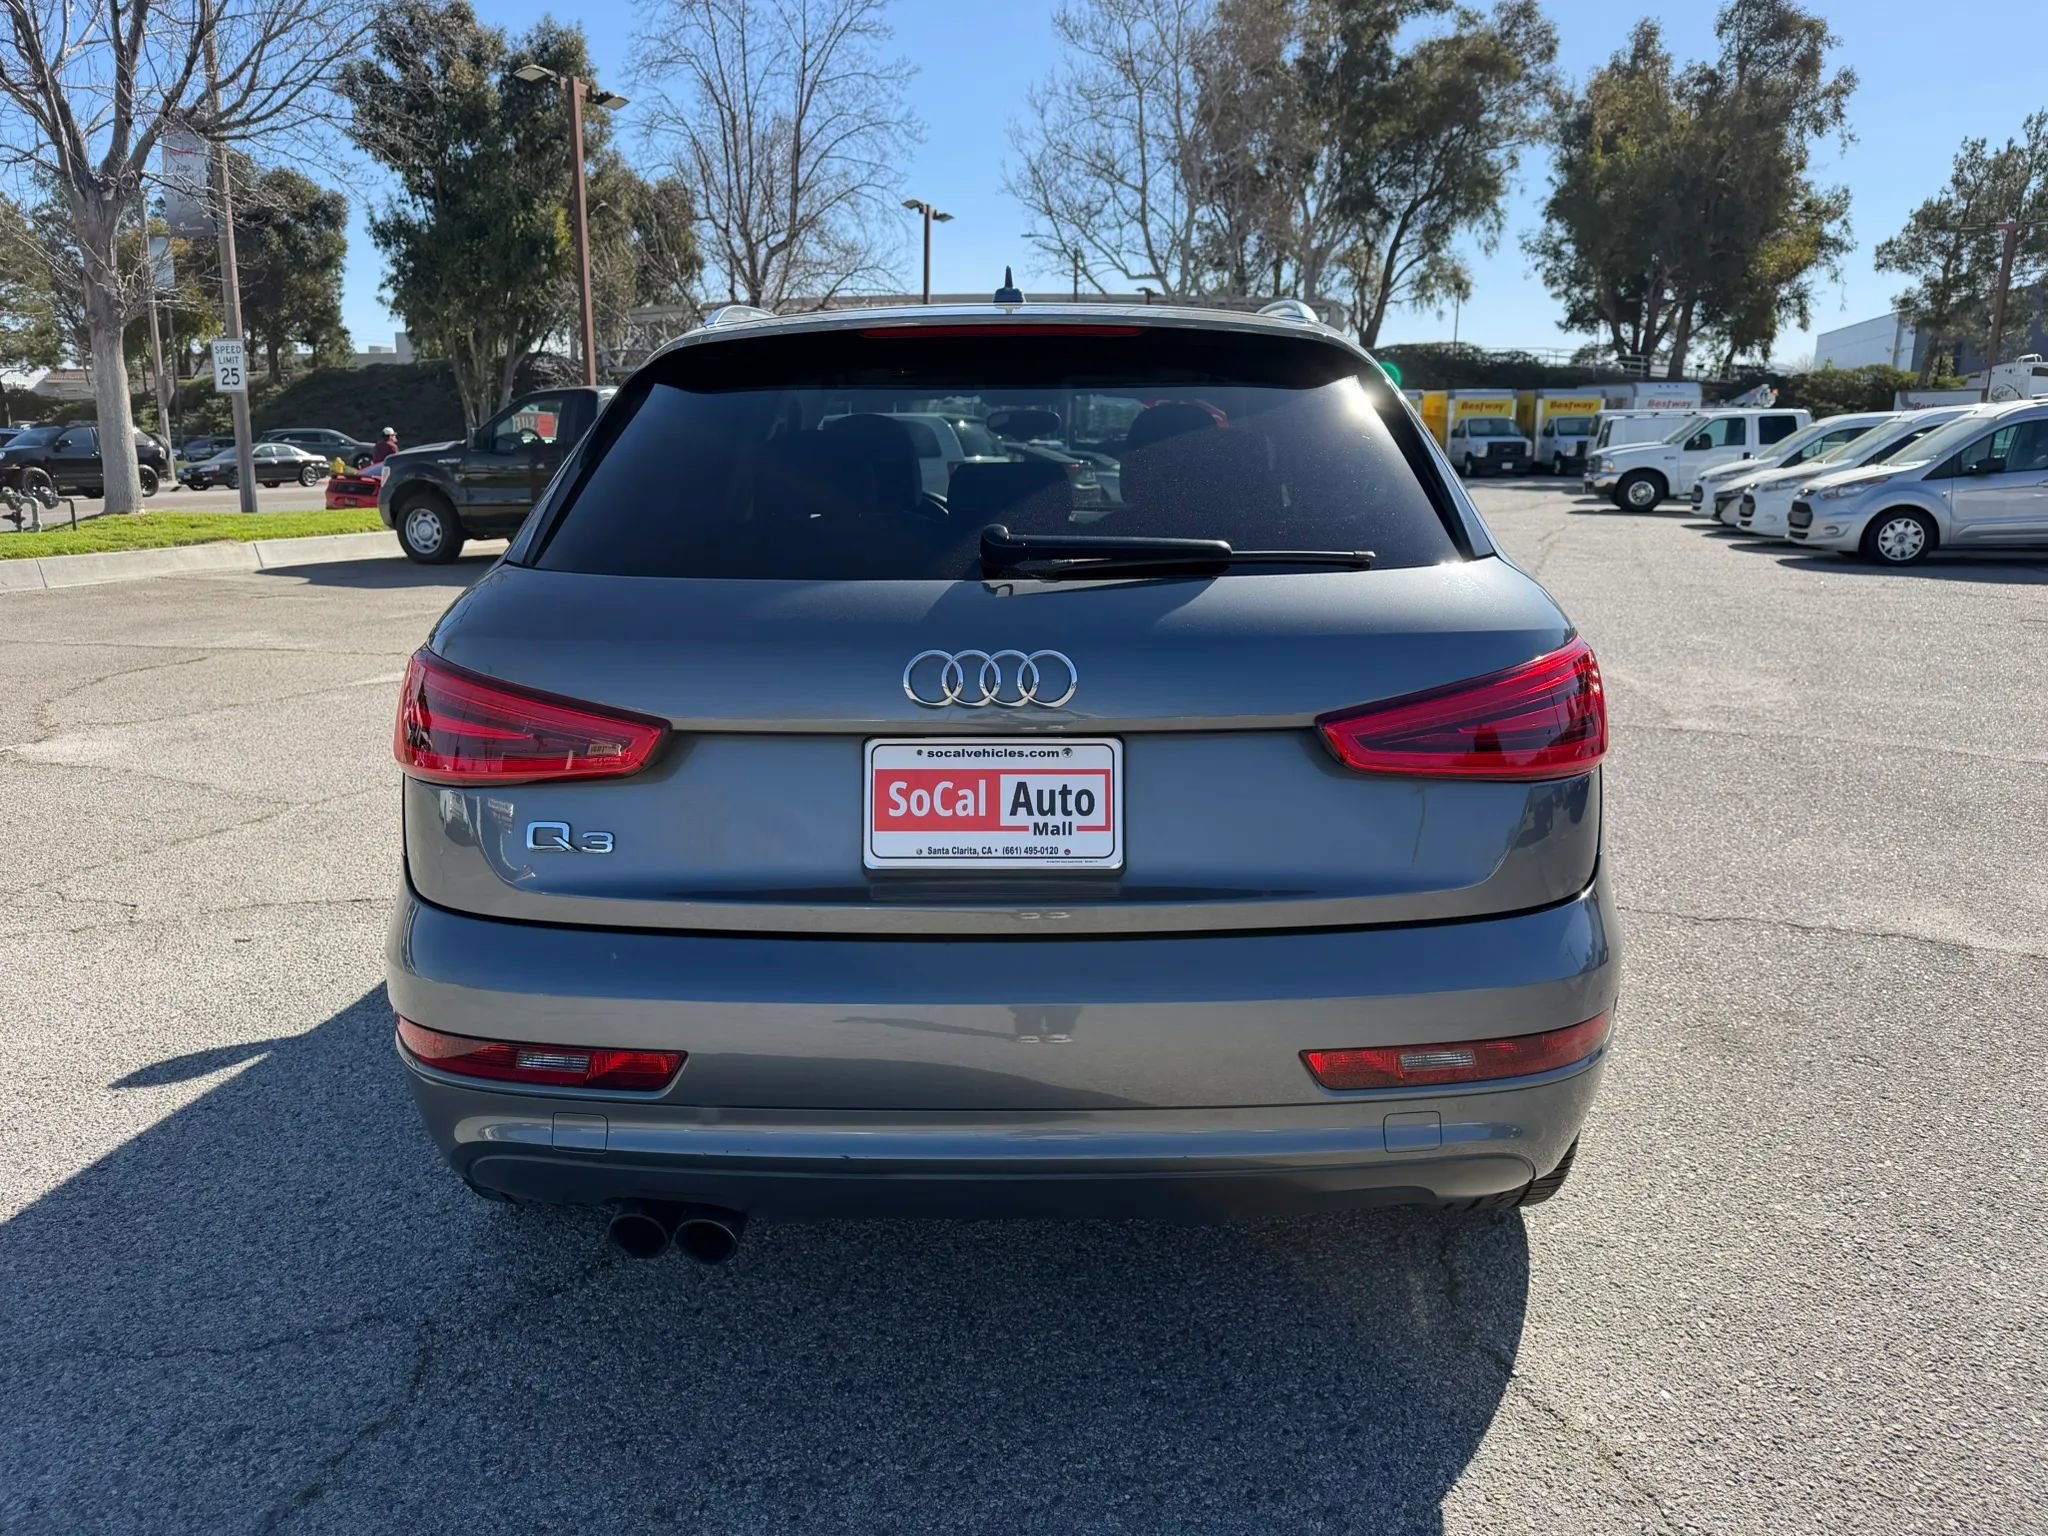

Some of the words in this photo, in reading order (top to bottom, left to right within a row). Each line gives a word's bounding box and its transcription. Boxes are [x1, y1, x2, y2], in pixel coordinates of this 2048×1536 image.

[215, 345, 242, 354] SPEED
[218, 356, 239, 365] LIMIT
[220, 367, 240, 386] 25
[1461, 401, 1505, 413] Bestway
[1550, 400, 1594, 412] Bestway
[927, 748, 1060, 758] socalvehicles.com
[888, 779, 987, 817] SoCal
[1009, 781, 1096, 817] Auto
[1032, 821, 1073, 836] Mall
[526, 821, 614, 854] Q3
[927, 846, 950, 855] Santa
[951, 846, 979, 857] Clarita,
[981, 846, 993, 855] CA
[1002, 846, 1022, 855] (661)
[1023, 846, 1059, 855] 495-0120
